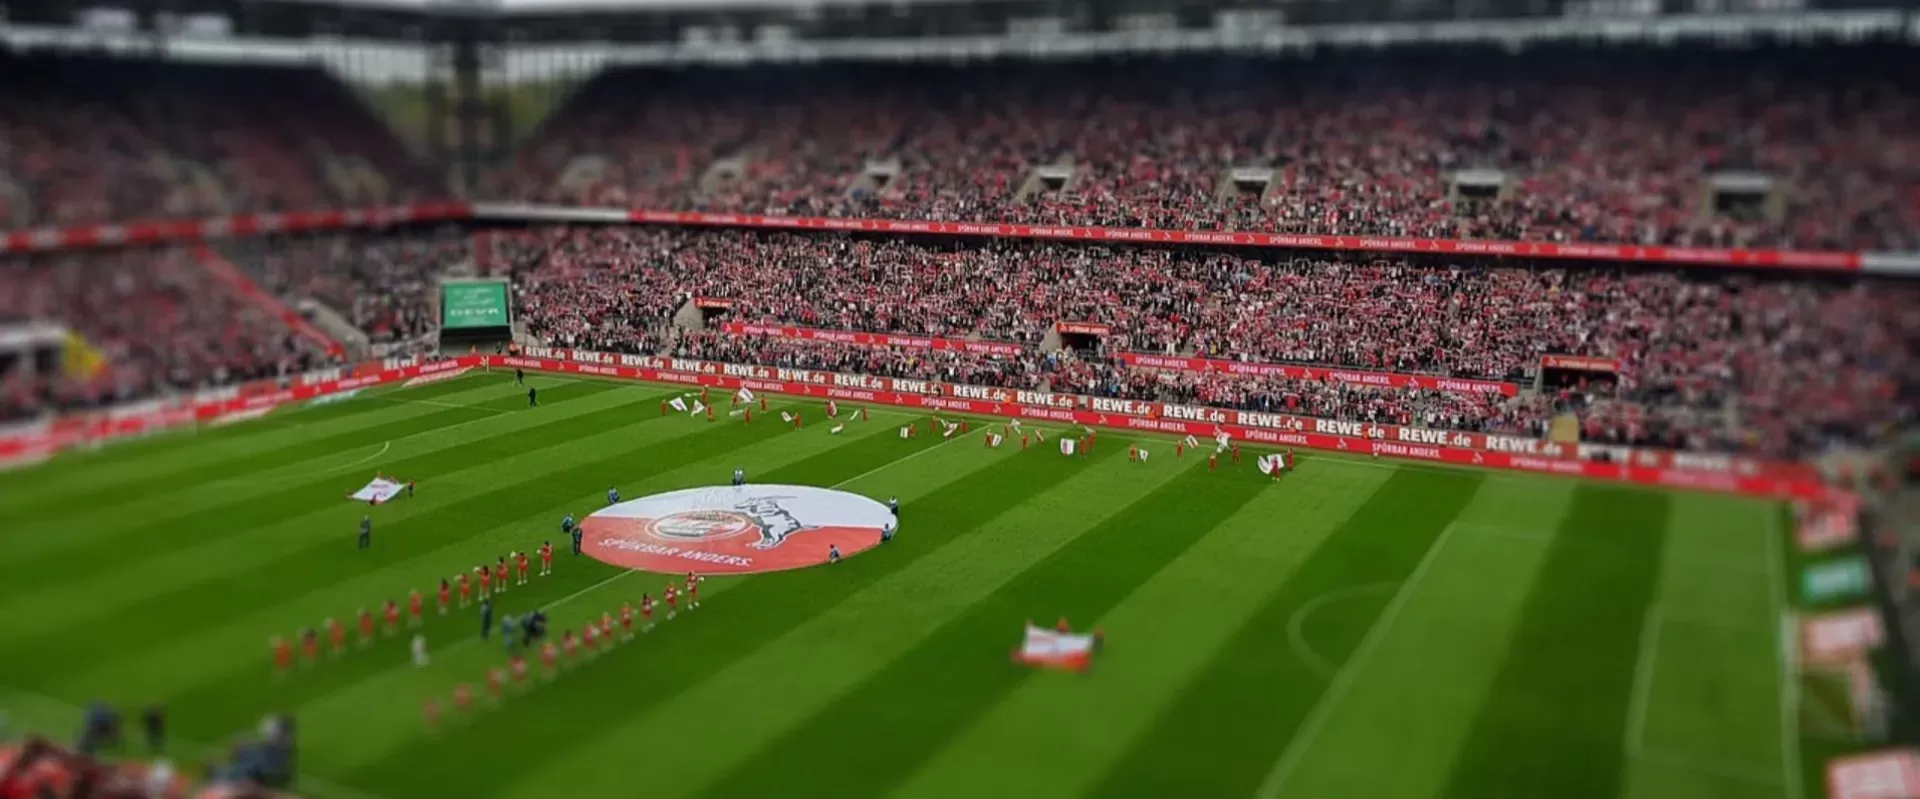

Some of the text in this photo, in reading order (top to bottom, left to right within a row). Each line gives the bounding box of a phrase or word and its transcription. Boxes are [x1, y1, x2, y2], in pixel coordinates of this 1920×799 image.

[672, 358, 716, 373] REWE.de
[724, 363, 769, 378] REWE.de
[834, 373, 883, 390] REWE.de
[953, 385, 1006, 401] REWE.de
[1017, 391, 1073, 408] REWE.de
[1093, 397, 1151, 415] REWE.de
[1163, 404, 1226, 423] REWE.de
[1316, 419, 1385, 439] REWEde
[1400, 425, 1472, 448] REWE.de
